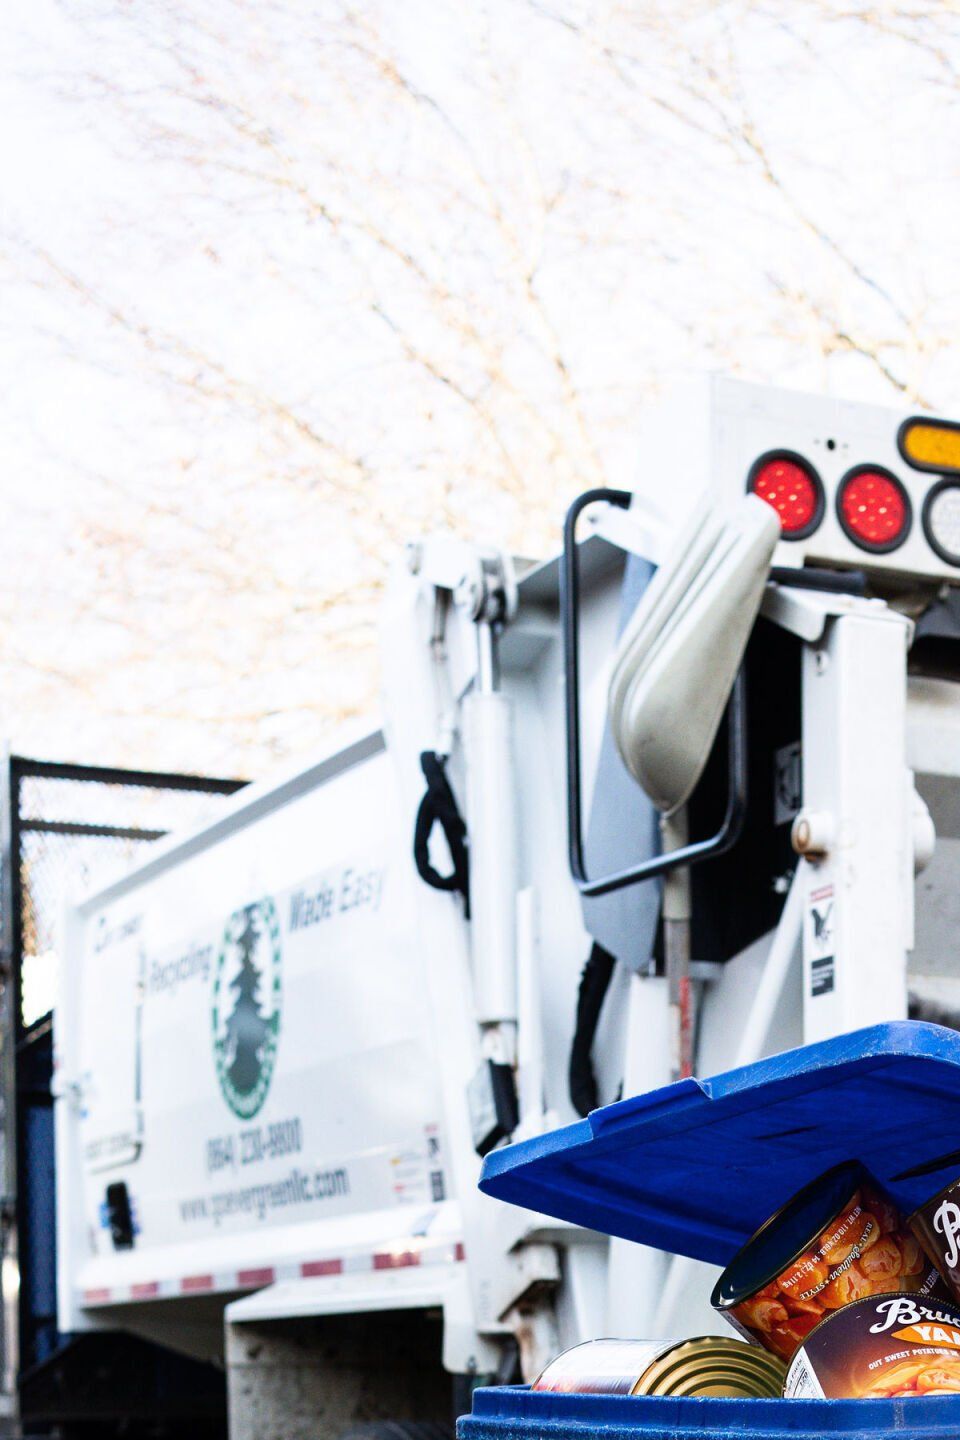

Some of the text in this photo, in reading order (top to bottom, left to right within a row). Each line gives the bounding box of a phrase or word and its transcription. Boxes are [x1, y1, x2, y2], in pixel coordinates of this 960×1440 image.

[829, 1243, 861, 1281] Southern
[799, 1283, 826, 1301] STYLE
[884, 1350, 911, 1363] SWEET
